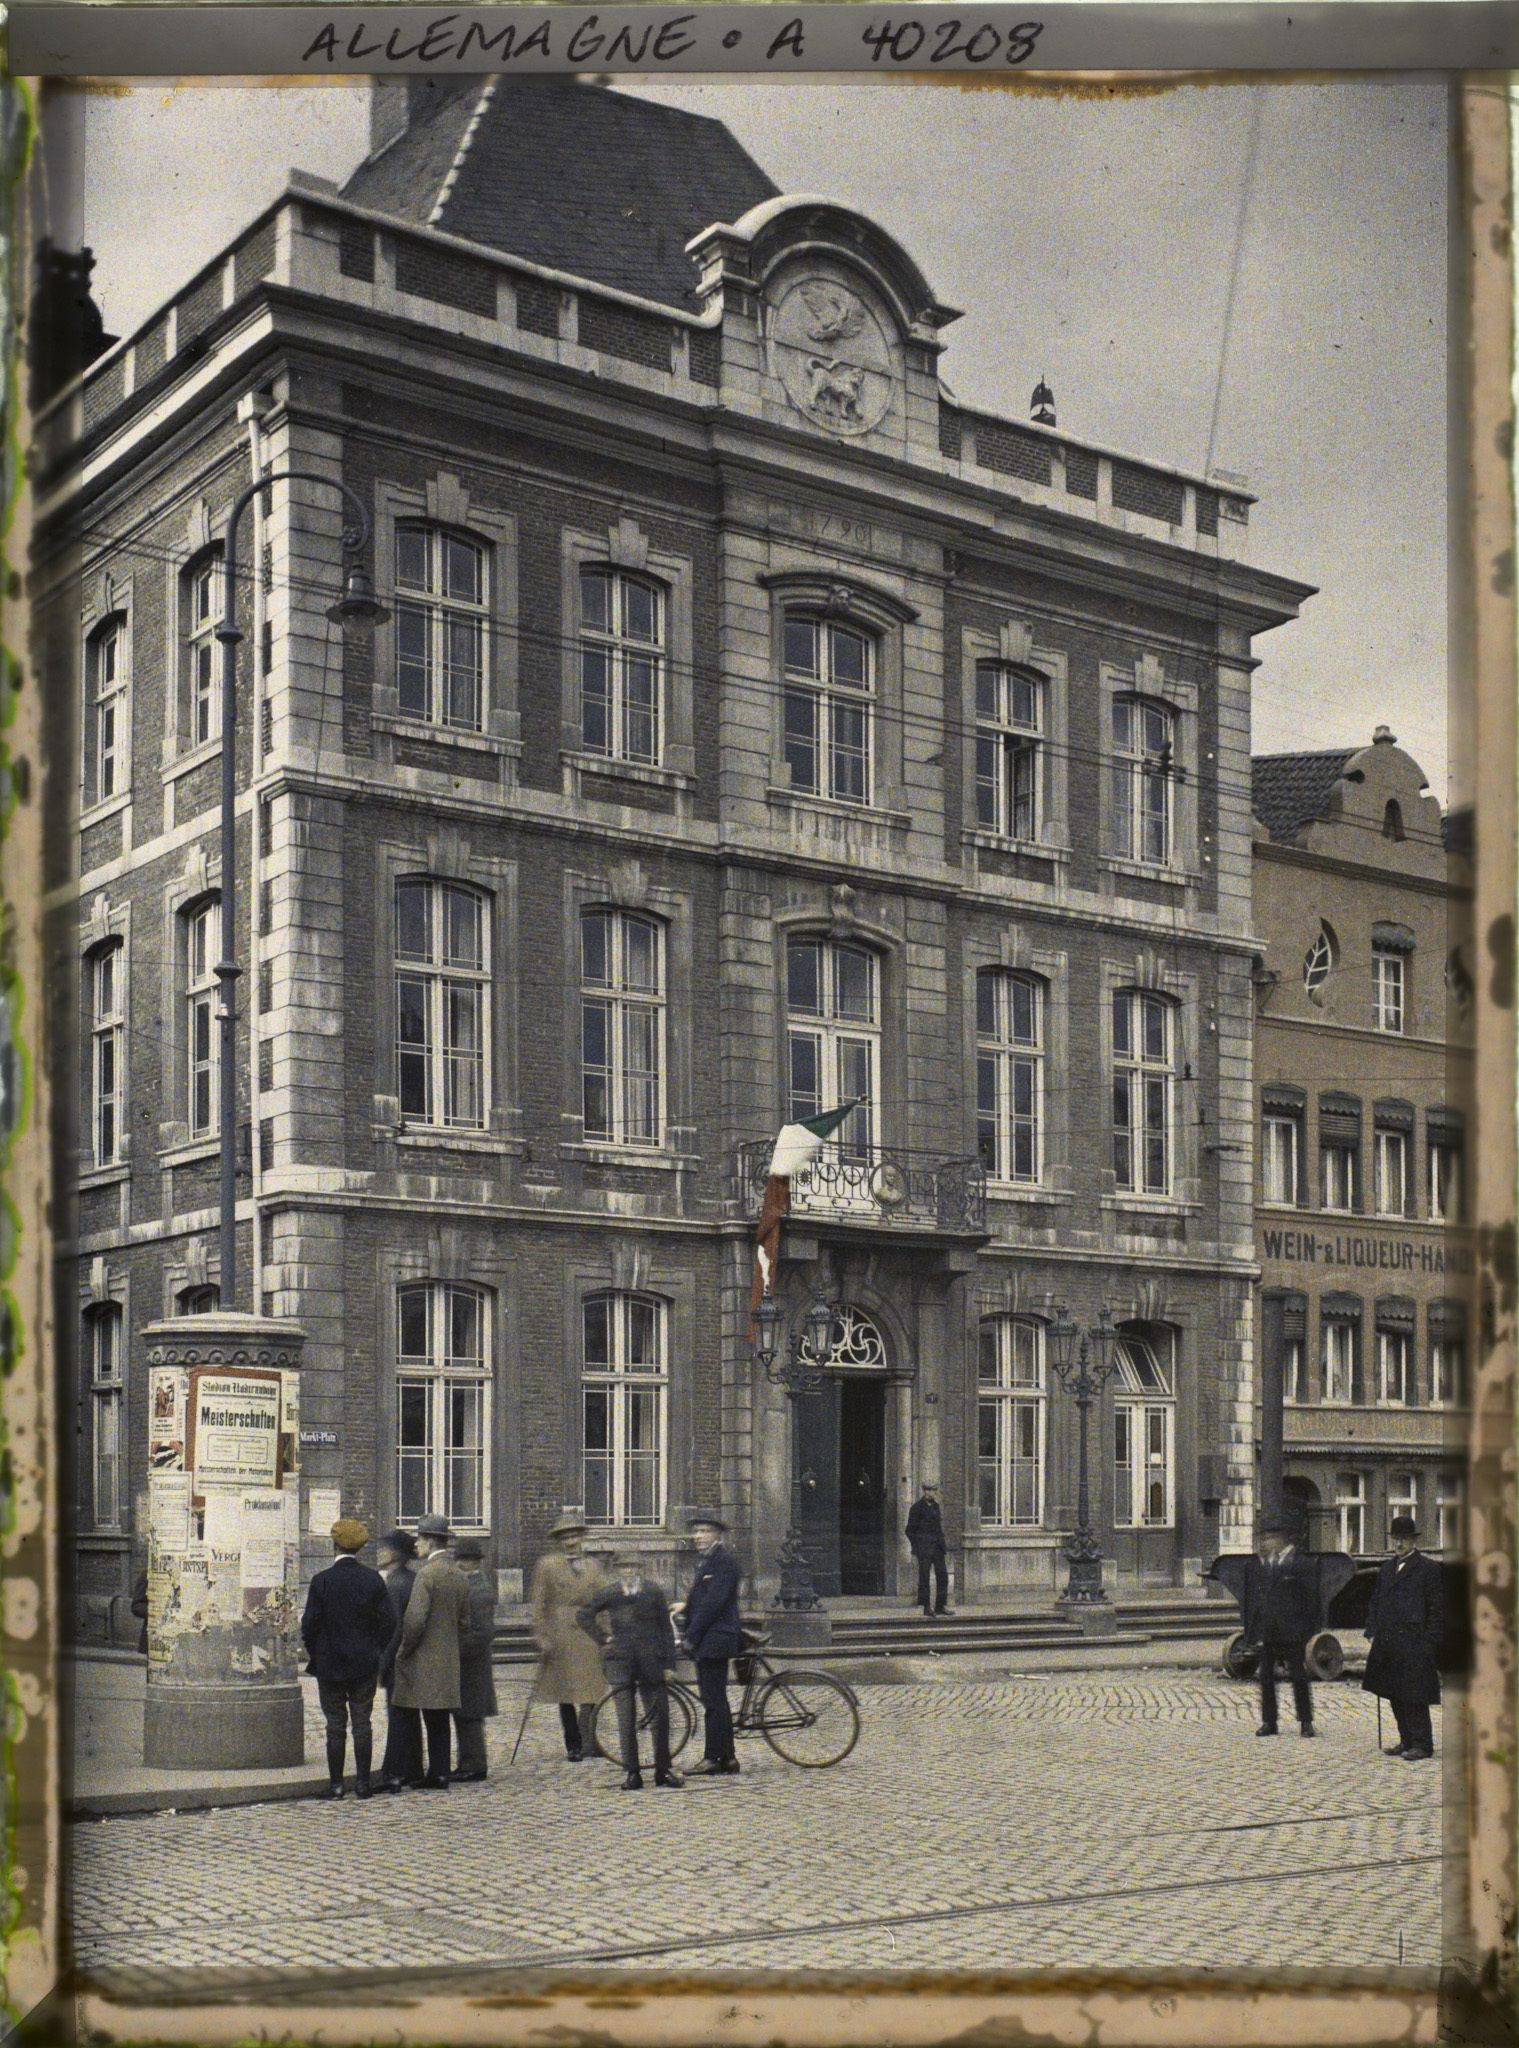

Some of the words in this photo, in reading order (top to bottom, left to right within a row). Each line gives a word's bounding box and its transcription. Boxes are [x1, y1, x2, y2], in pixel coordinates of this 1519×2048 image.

[302, 14, 696, 63] ALLEMAGNE
[765, 18, 805, 59] A
[862, 20, 1044, 64] 40208
[201, 1406, 276, 1430] Meisterschaften
